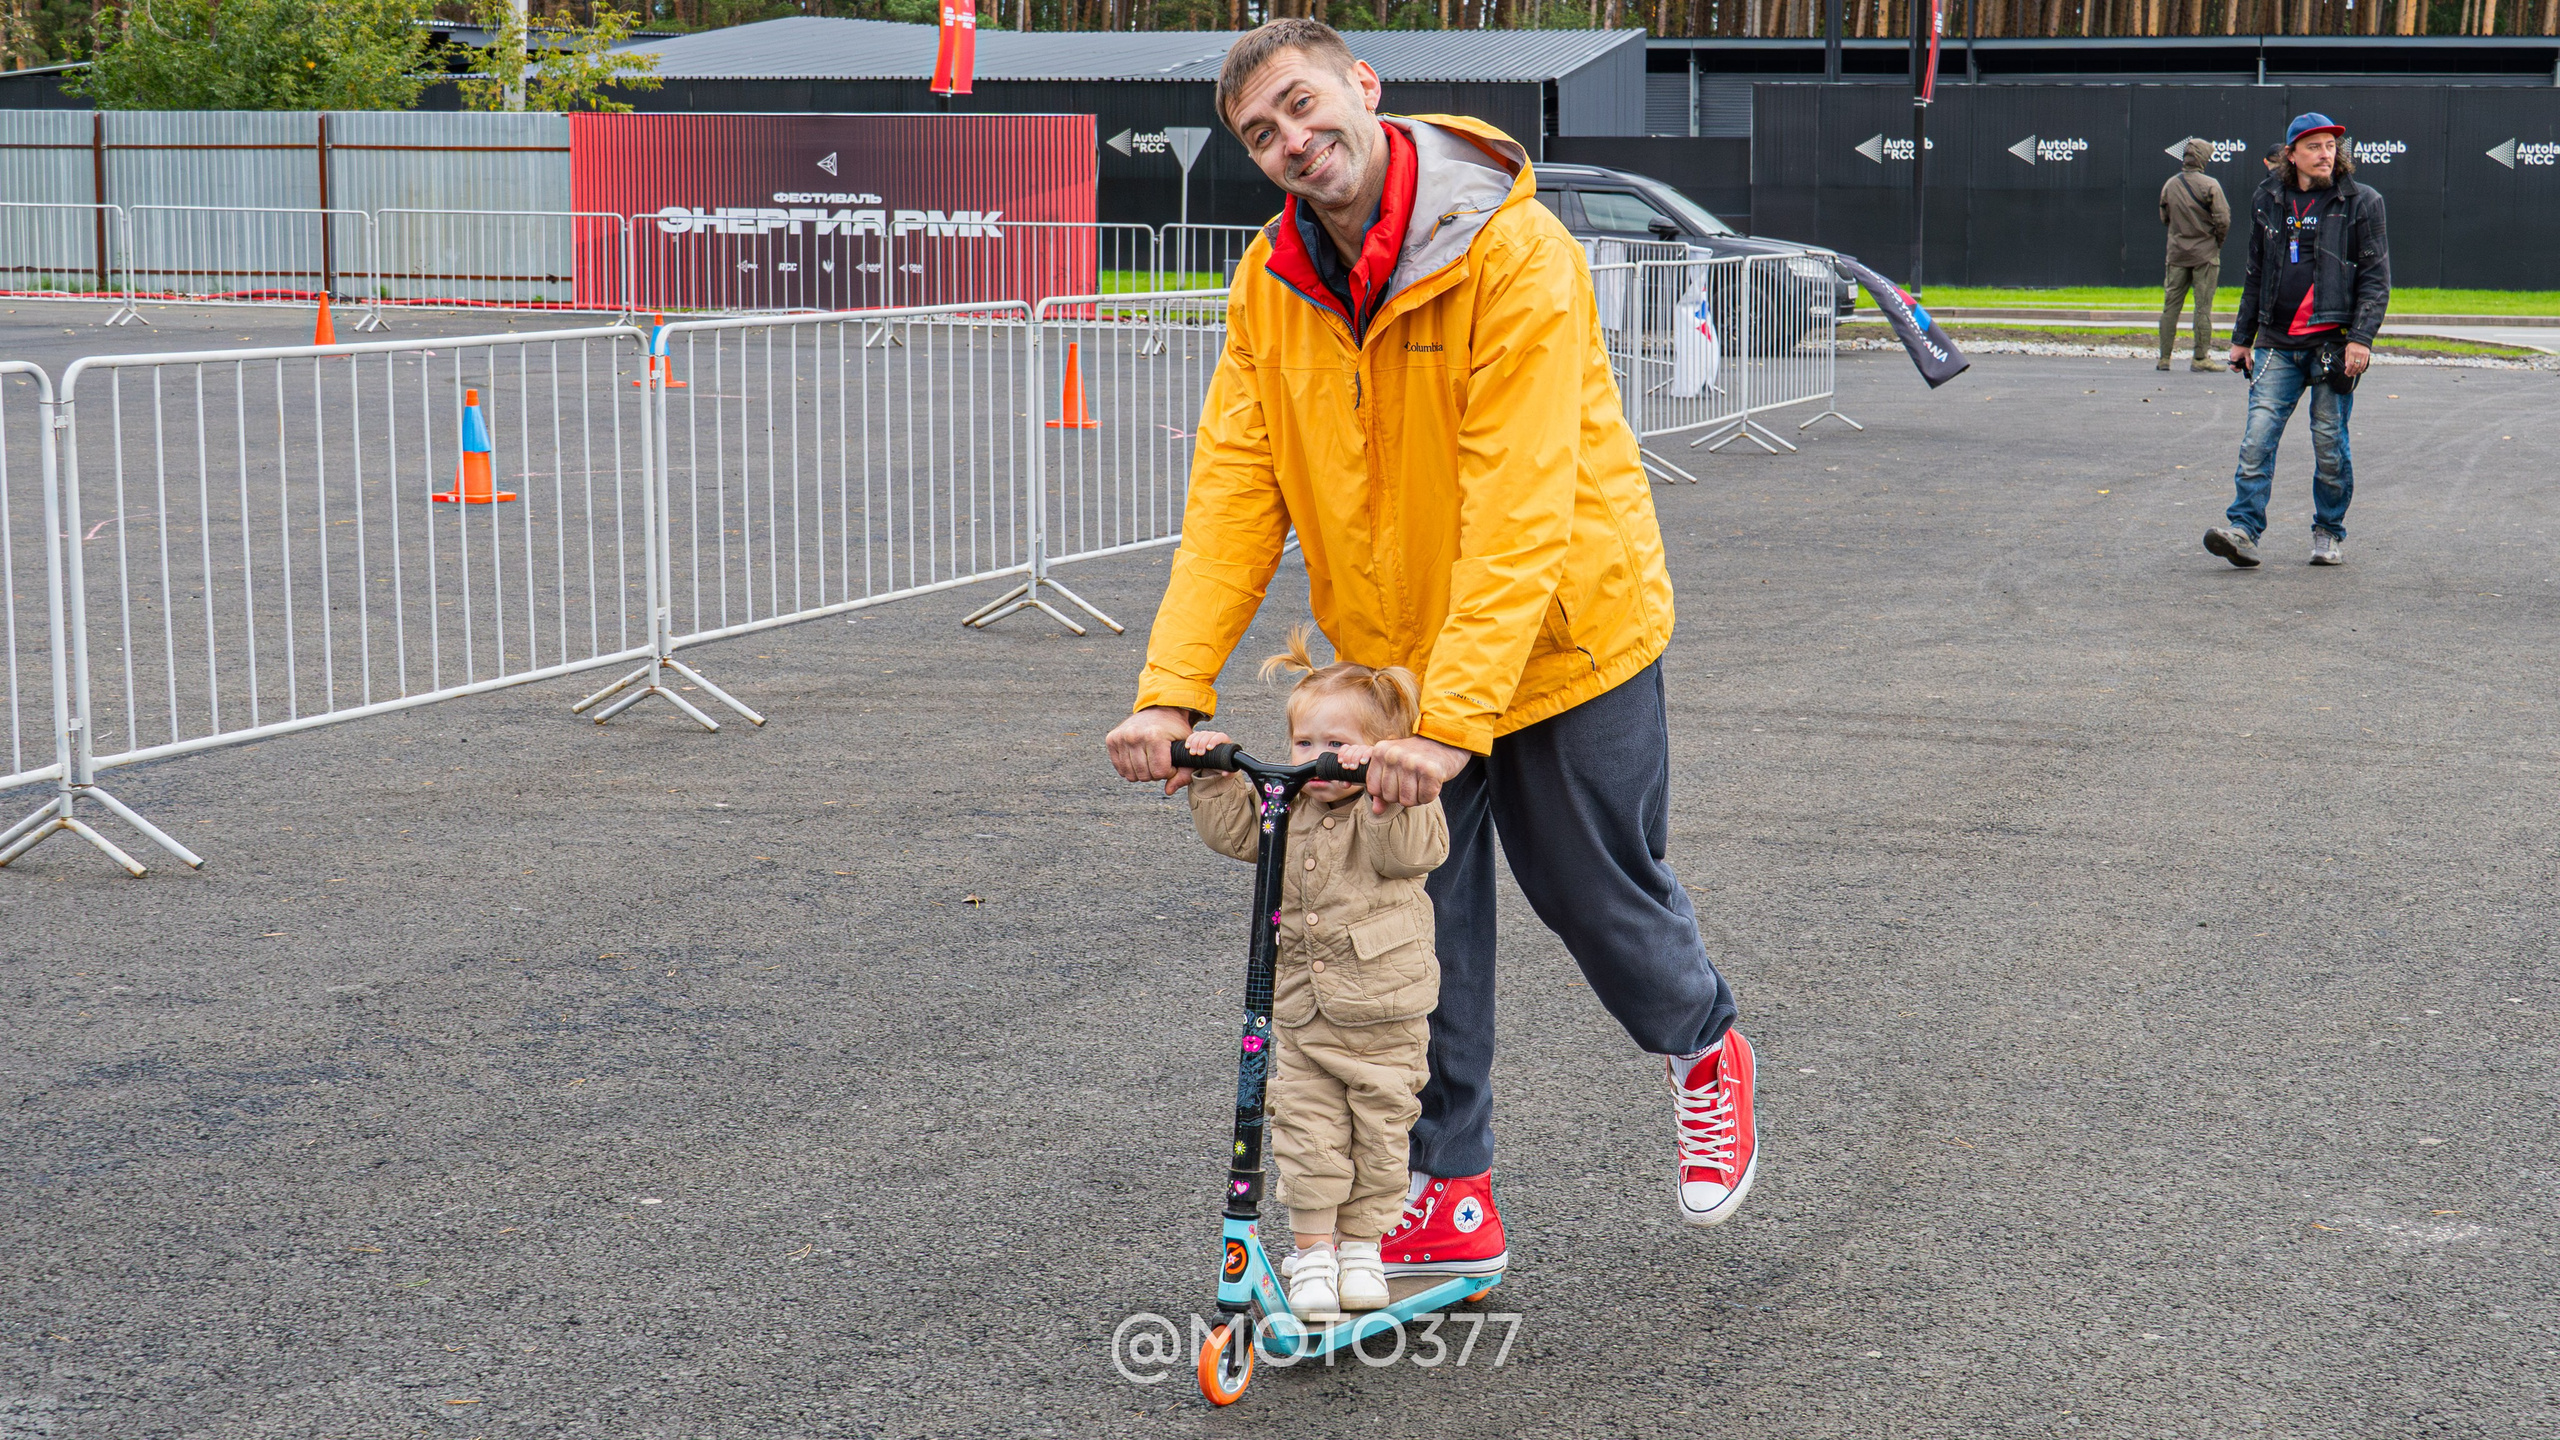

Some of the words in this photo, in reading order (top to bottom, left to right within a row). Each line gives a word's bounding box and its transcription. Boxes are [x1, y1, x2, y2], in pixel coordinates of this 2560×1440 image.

[1132, 131, 1170, 143] Autola
[1139, 143, 1166, 153] RCC
[1883, 137, 1934, 150] Autob
[2037, 138, 2089, 151] Autolab
[2211, 139, 2247, 152] tolab
[2353, 140, 2407, 153] Autolab
[2516, 141, 2560, 154] Autola
[2045, 150, 2074, 161] RCC
[2208, 151, 2232, 162] CC
[2361, 152, 2391, 164] RCC
[2524, 153, 2555, 165] RCC
[772, 192, 883, 205] ФЕСТИВАЛЬ
[657, 206, 887, 237] ЭНЕРГИЯ
[893, 209, 1004, 238] РМК
[778, 262, 798, 272] RCC
[1403, 341, 1443, 352] Columbia
[1443, 689, 1495, 710] OMNI-TECH
